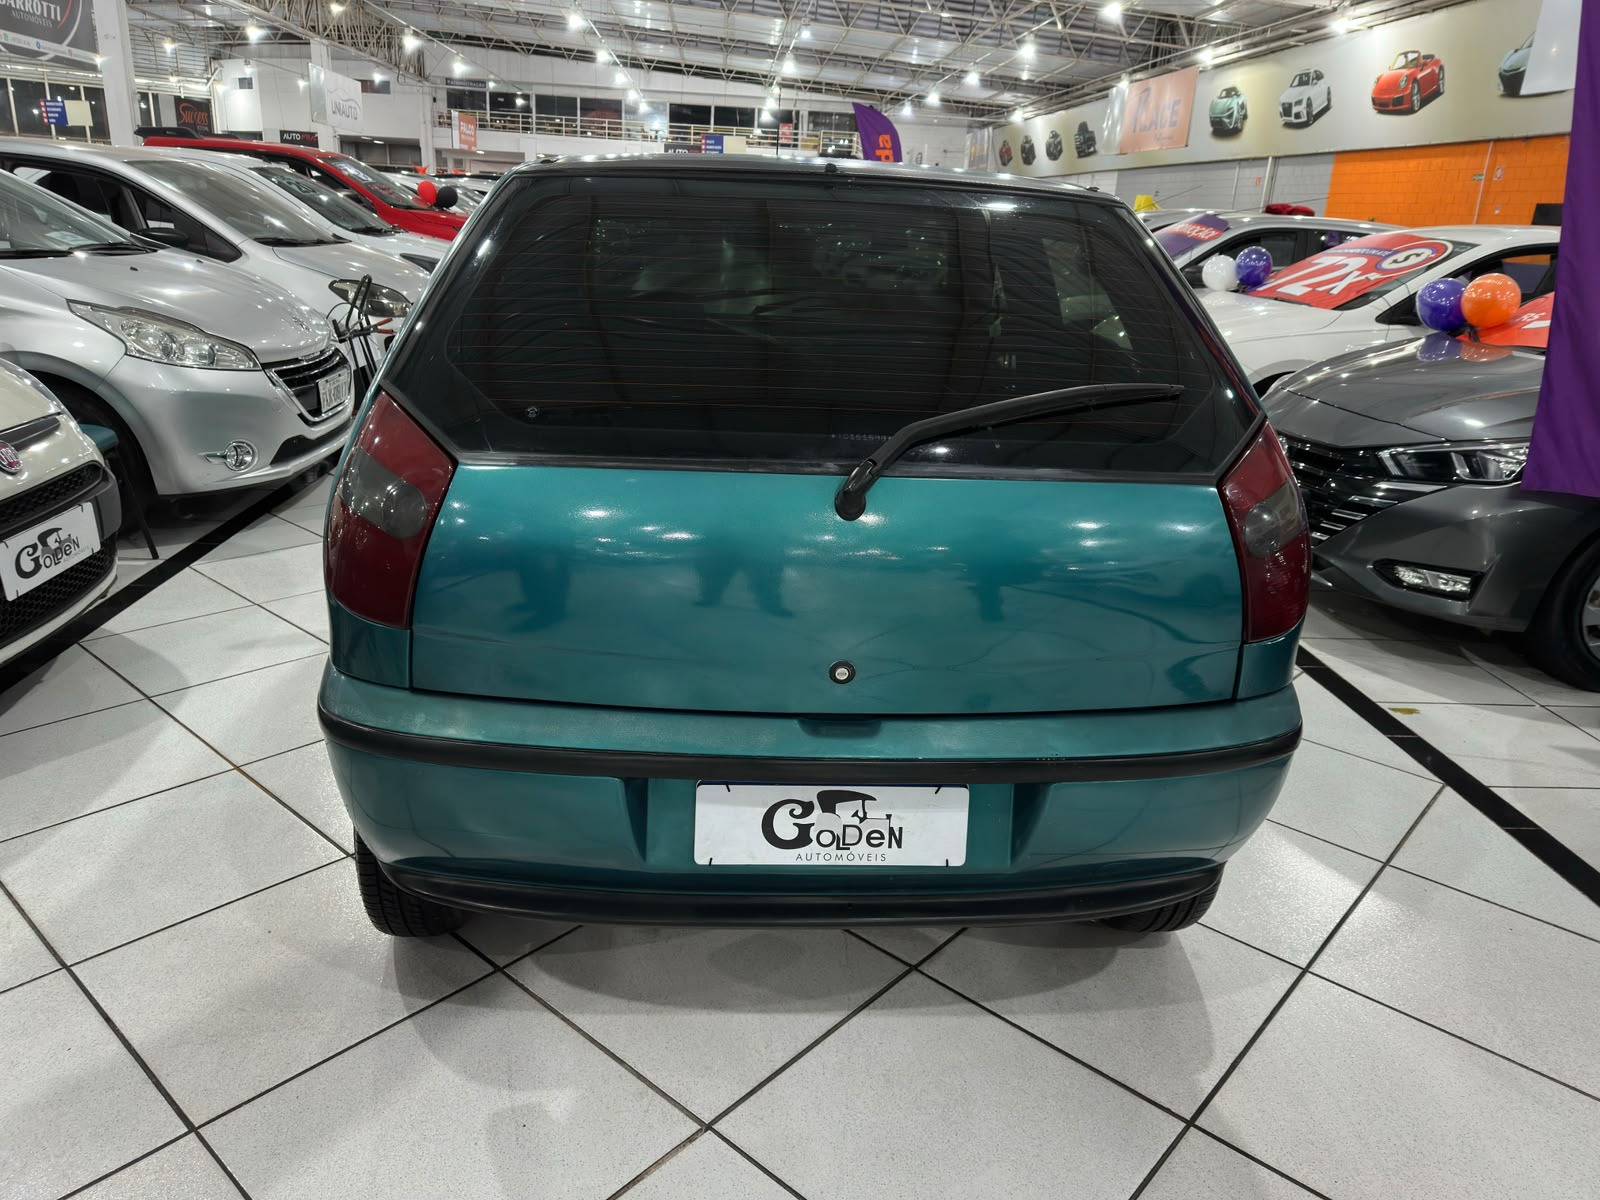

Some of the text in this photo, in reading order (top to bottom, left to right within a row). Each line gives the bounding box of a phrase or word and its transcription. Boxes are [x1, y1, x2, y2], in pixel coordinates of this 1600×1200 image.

[0, 0, 61, 22] ARROTTI
[283, 132, 301, 141] AUTO
[796, 851, 887, 862] AUTOMÓVEIS
